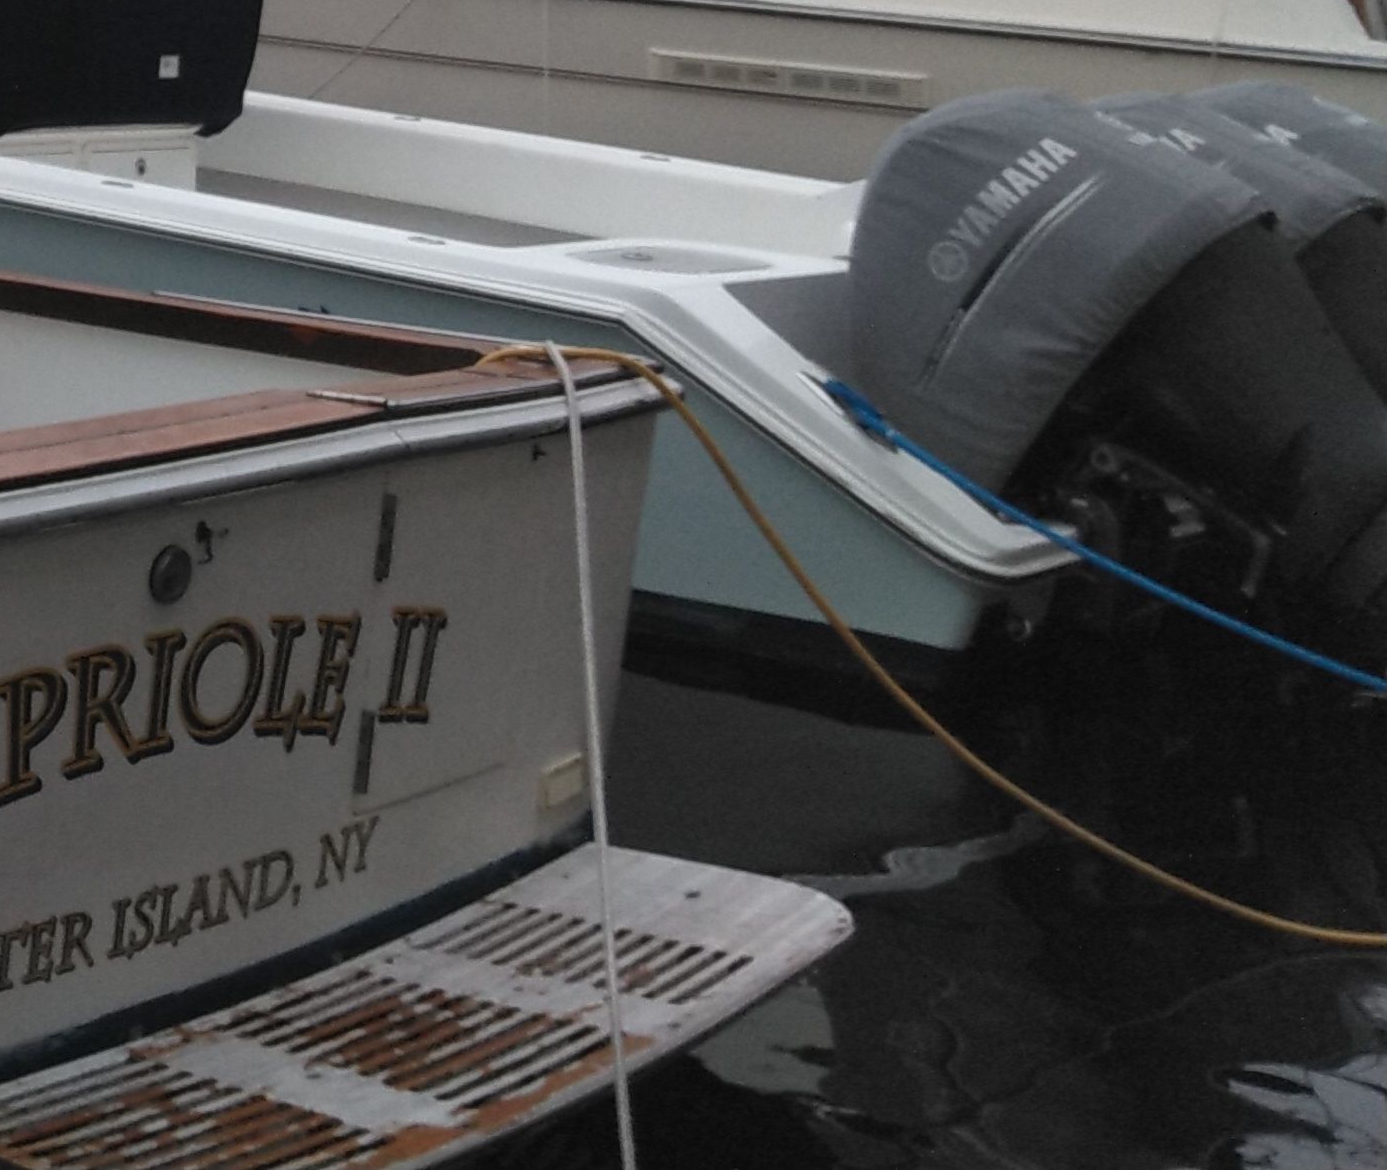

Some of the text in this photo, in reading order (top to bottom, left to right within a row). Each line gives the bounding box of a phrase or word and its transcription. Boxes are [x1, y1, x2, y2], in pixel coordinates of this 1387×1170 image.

[948, 138, 1077, 246] YAMAHA
[378, 606, 448, 723] II
[107, 850, 301, 958] ISLAND,
[315, 815, 379, 891] NY
